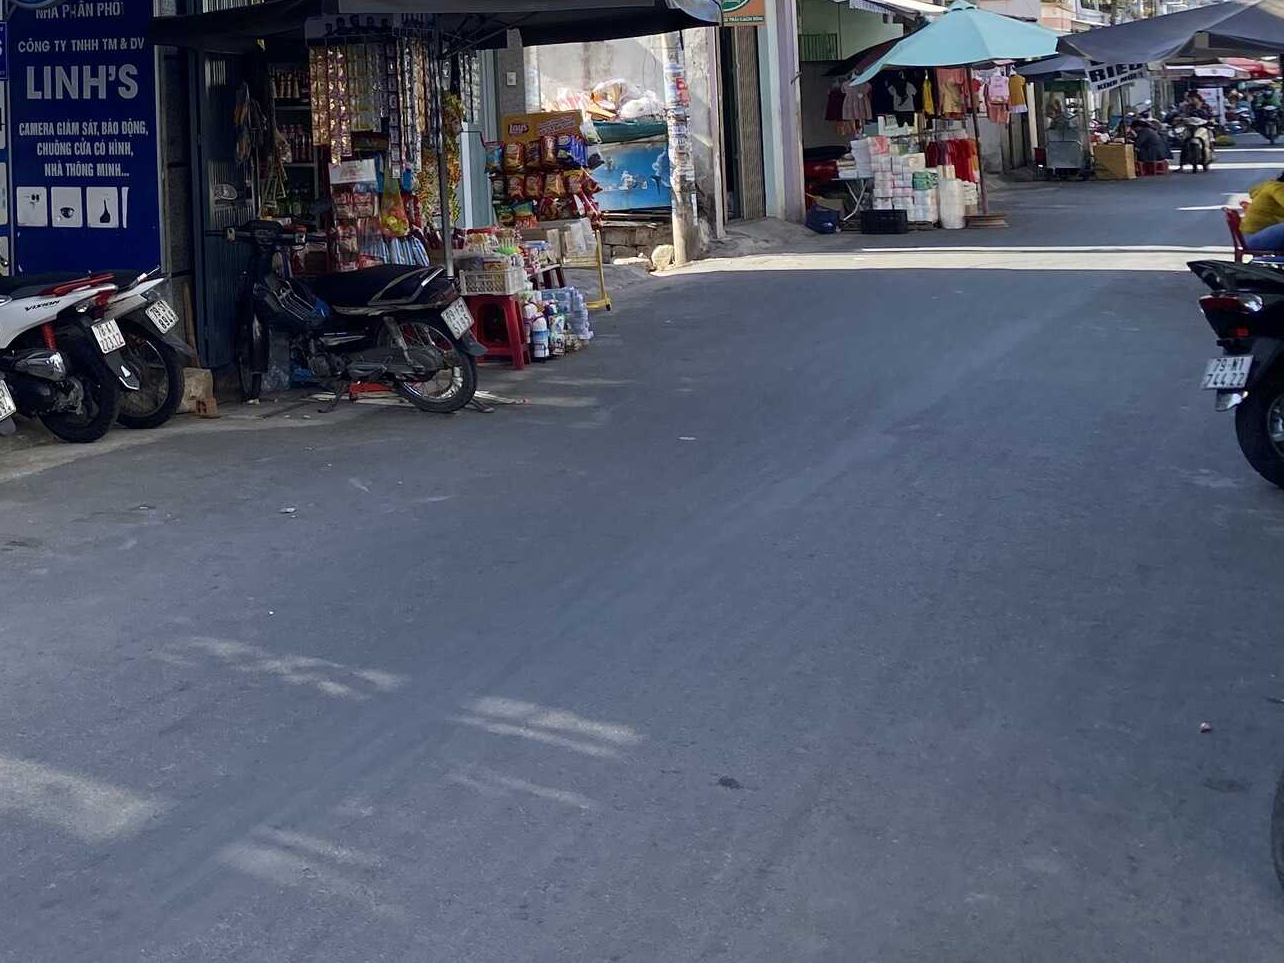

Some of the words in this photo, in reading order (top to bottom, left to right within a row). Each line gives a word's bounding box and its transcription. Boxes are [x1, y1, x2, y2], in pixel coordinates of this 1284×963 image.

[17, 37, 51, 53] CÔNG
[54, 39, 67, 52] TY
[70, 38, 99, 52] TNHH
[102, 37, 117, 51] TM
[120, 37, 128, 50] &
[26, 63, 140, 100] LINH'S
[18, 121, 55, 136] CAMERA
[36, 139, 72, 156] CHUÔNG
[65, 160, 94, 177] THÔNG
